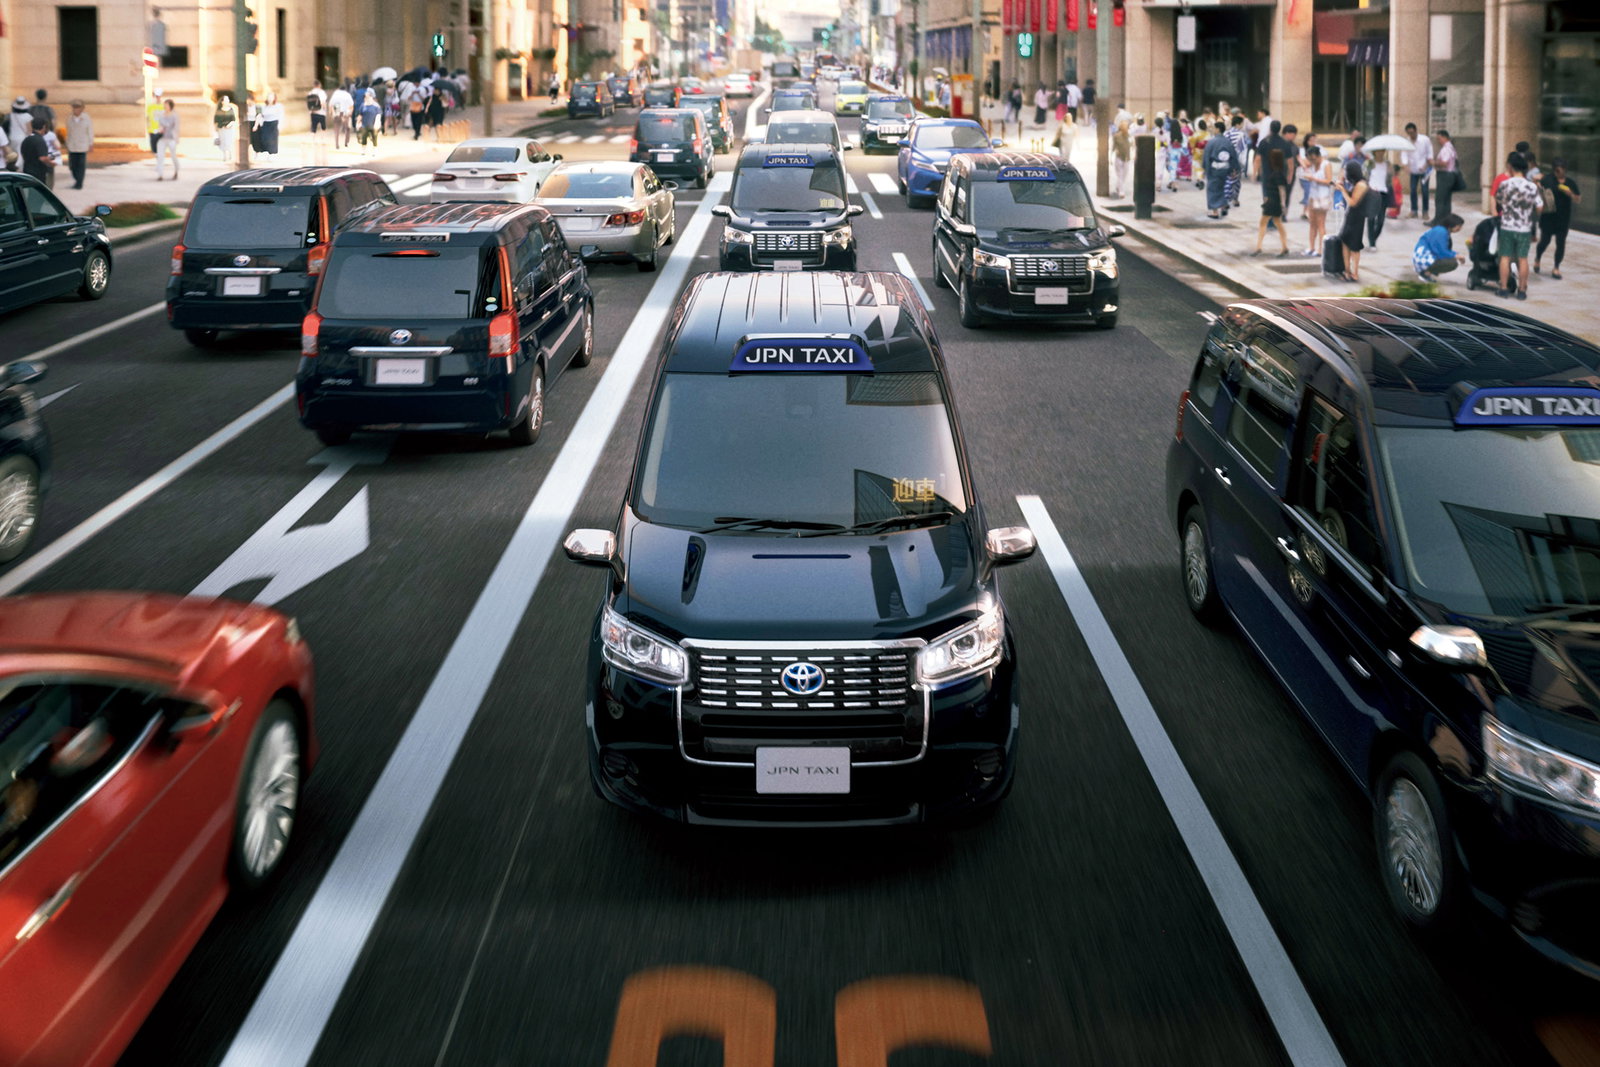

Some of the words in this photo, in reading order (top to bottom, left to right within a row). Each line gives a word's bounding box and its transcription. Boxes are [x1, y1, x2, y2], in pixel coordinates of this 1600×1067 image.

[1004, 170, 1025, 178] JPN
[745, 348, 793, 363] JPN
[801, 348, 854, 363] TAXI
[1473, 397, 1533, 416] JPN
[892, 477, 936, 502] 迎車
[767, 766, 799, 775] JPN
[803, 766, 840, 775] TAXI
